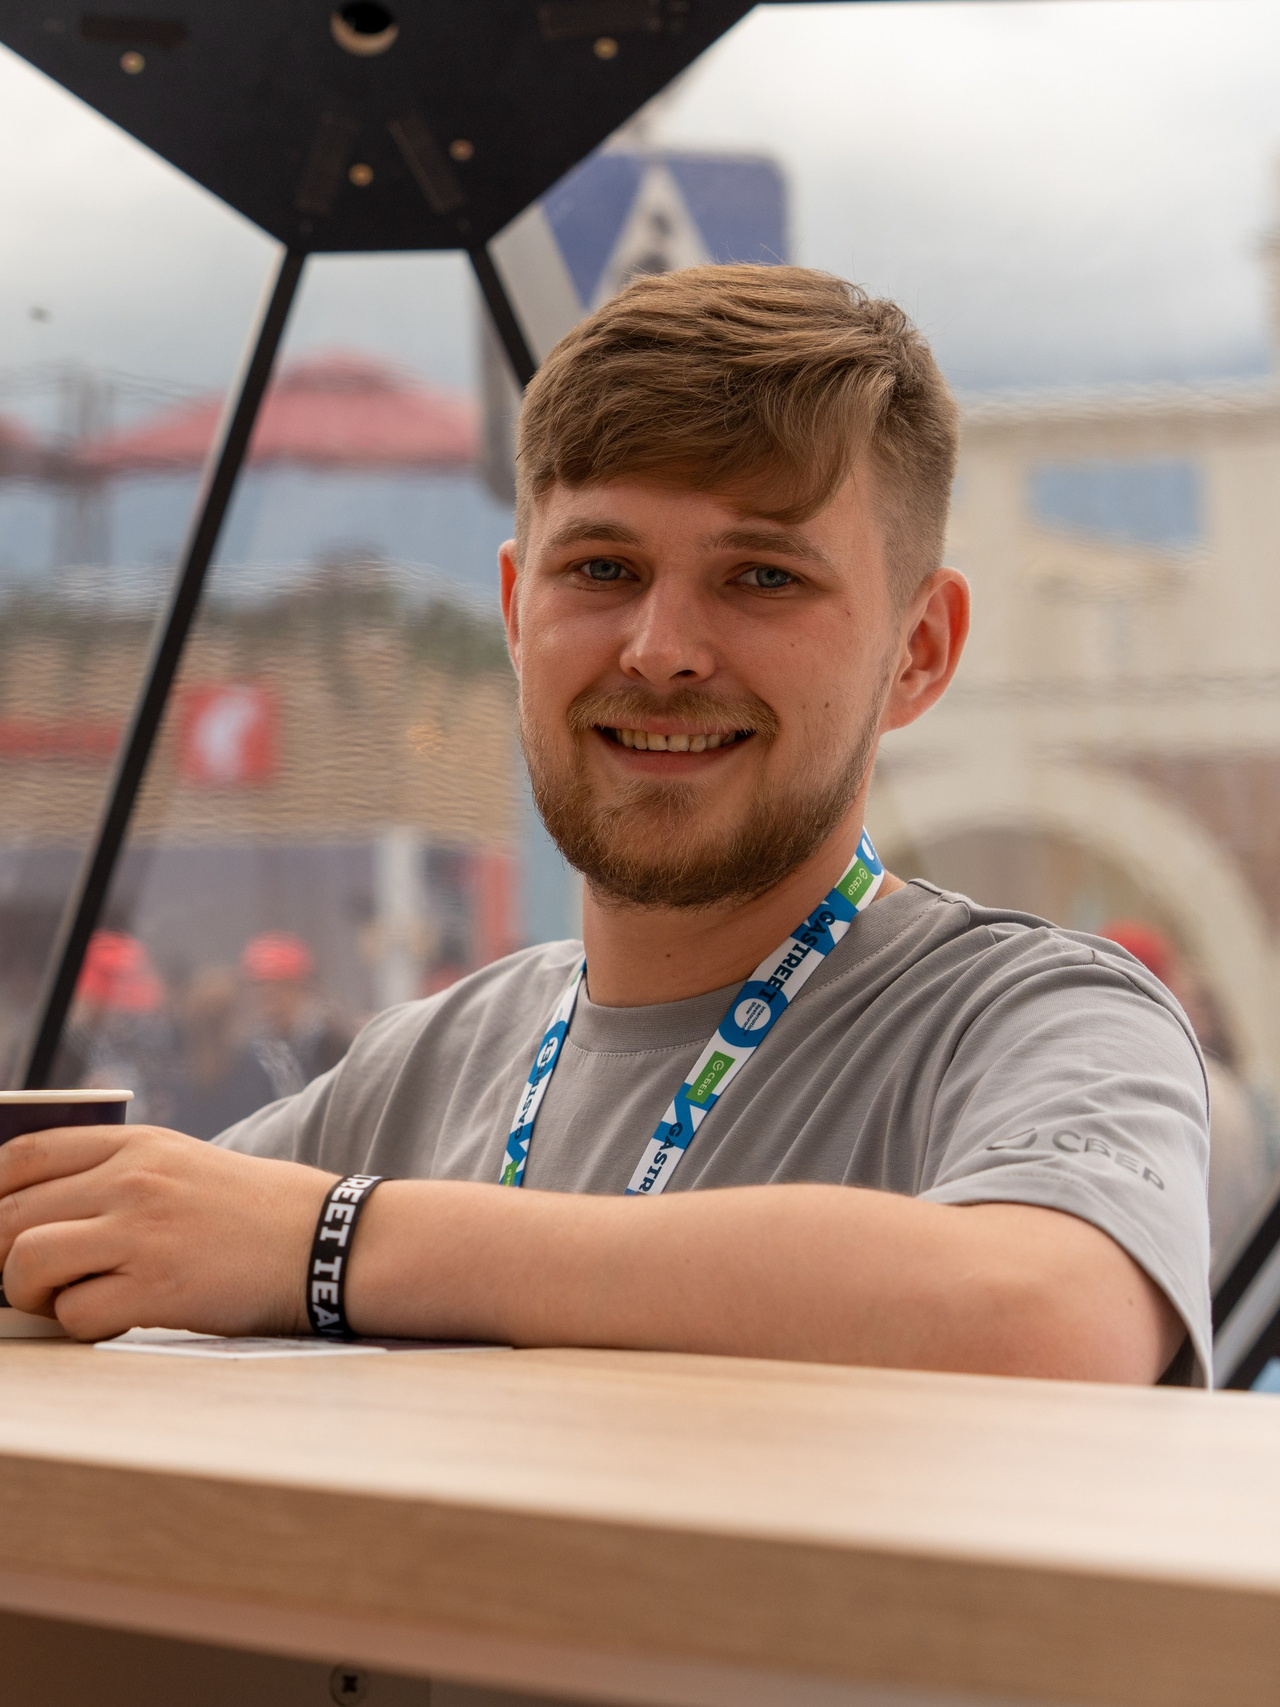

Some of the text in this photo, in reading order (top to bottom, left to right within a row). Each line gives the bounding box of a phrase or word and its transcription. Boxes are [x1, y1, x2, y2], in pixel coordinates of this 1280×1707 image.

[847, 876, 867, 896] СБЕР
[758, 910, 836, 1003] GASTREET
[514, 1039, 555, 1140] GASTREET
[697, 1072, 716, 1096] СБЕР
[637, 1121, 683, 1194] GASTR
[1051, 1129, 1165, 1191] СБЕР
[311, 1256, 345, 1334] TEA
